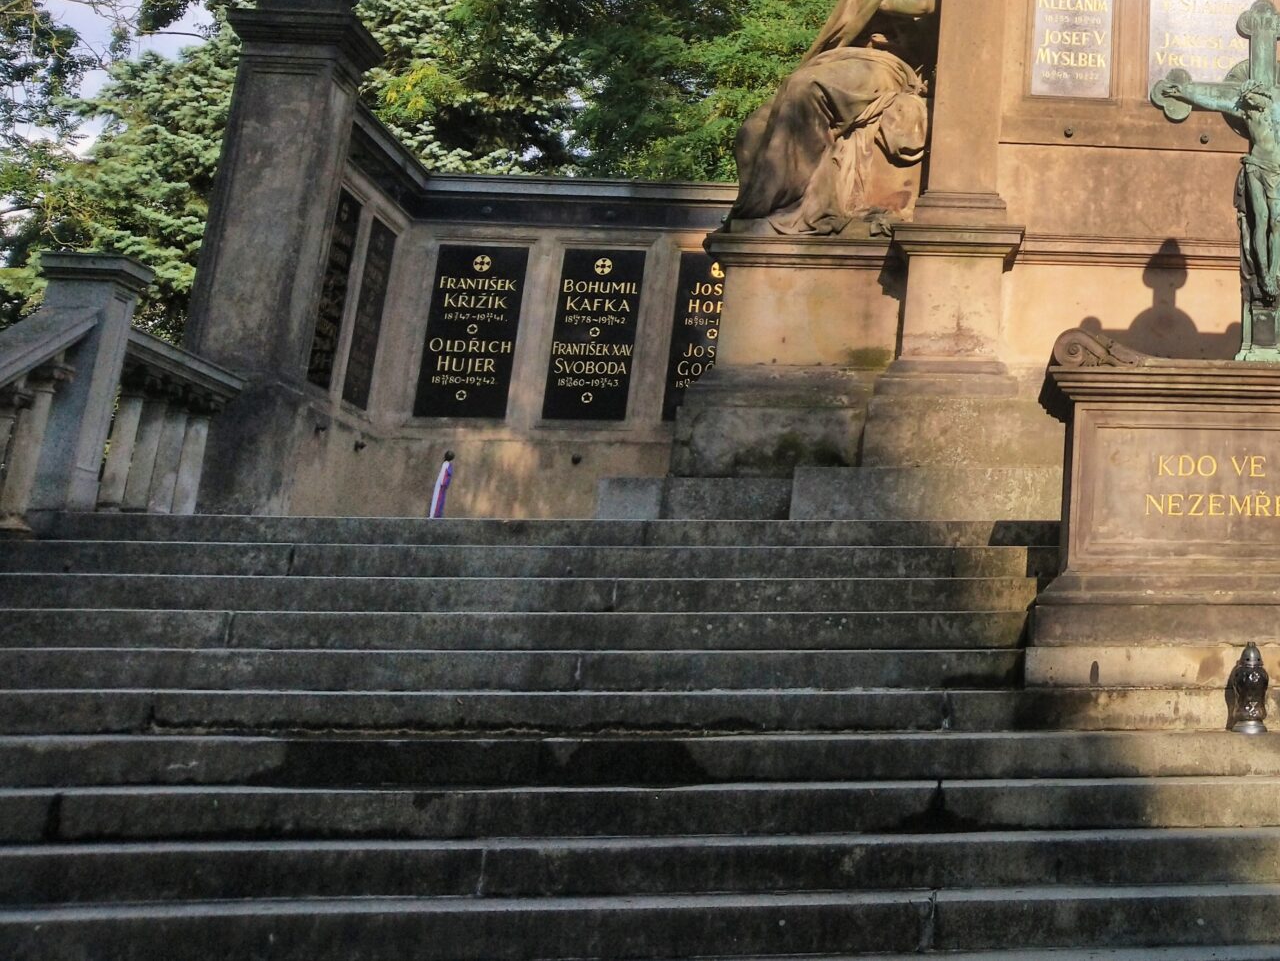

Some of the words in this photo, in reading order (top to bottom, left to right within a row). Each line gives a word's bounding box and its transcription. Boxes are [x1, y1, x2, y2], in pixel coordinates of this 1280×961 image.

[1042, 28, 1092, 47] JOSEF
[1036, 47, 1106, 68] MYSLBEK
[439, 275, 517, 291] FRANTIŠEK
[563, 279, 638, 294] BOHUMIL
[566, 296, 630, 312] KAFKA
[429, 337, 512, 353] OLDŘICH
[552, 341, 610, 356] FRANTIŠEK
[436, 355, 496, 374] HUJER
[554, 358, 627, 375] SVOBODA
[1158, 454, 1218, 477] KDO
[1231, 455, 1267, 478] VE
